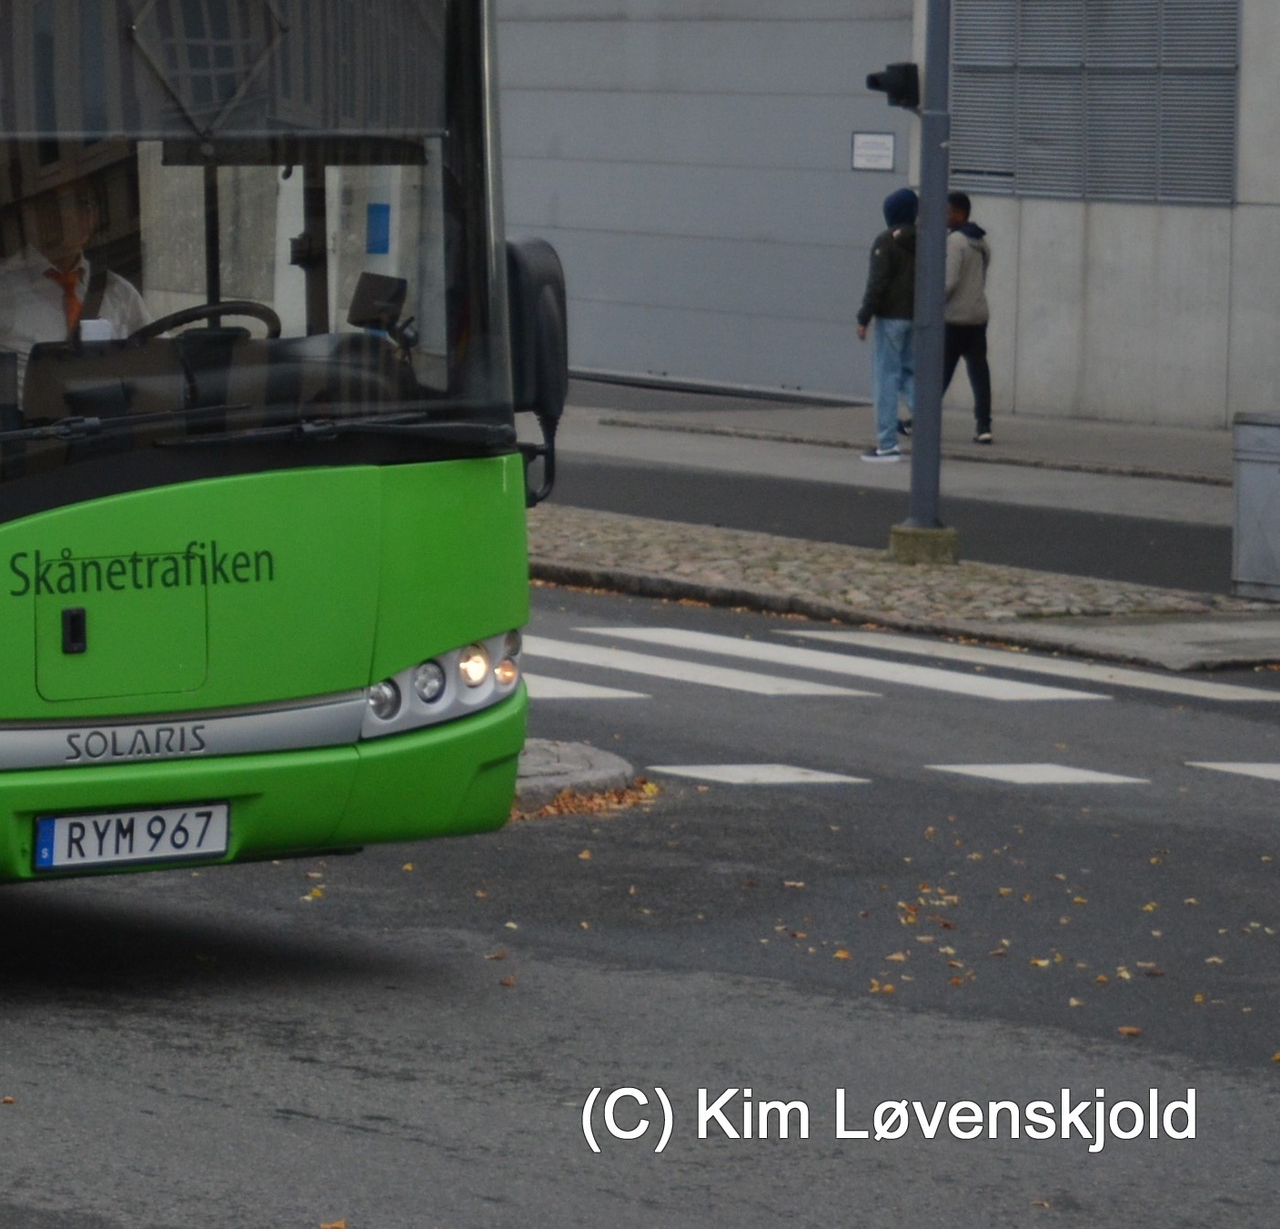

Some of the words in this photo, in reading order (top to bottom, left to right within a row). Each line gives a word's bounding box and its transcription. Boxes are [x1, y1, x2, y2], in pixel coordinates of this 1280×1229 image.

[9, 540, 275, 596] Skånetrafiken
[64, 724, 207, 762] SOLARIS
[67, 817, 135, 859] RYM
[146, 810, 213, 852] 967
